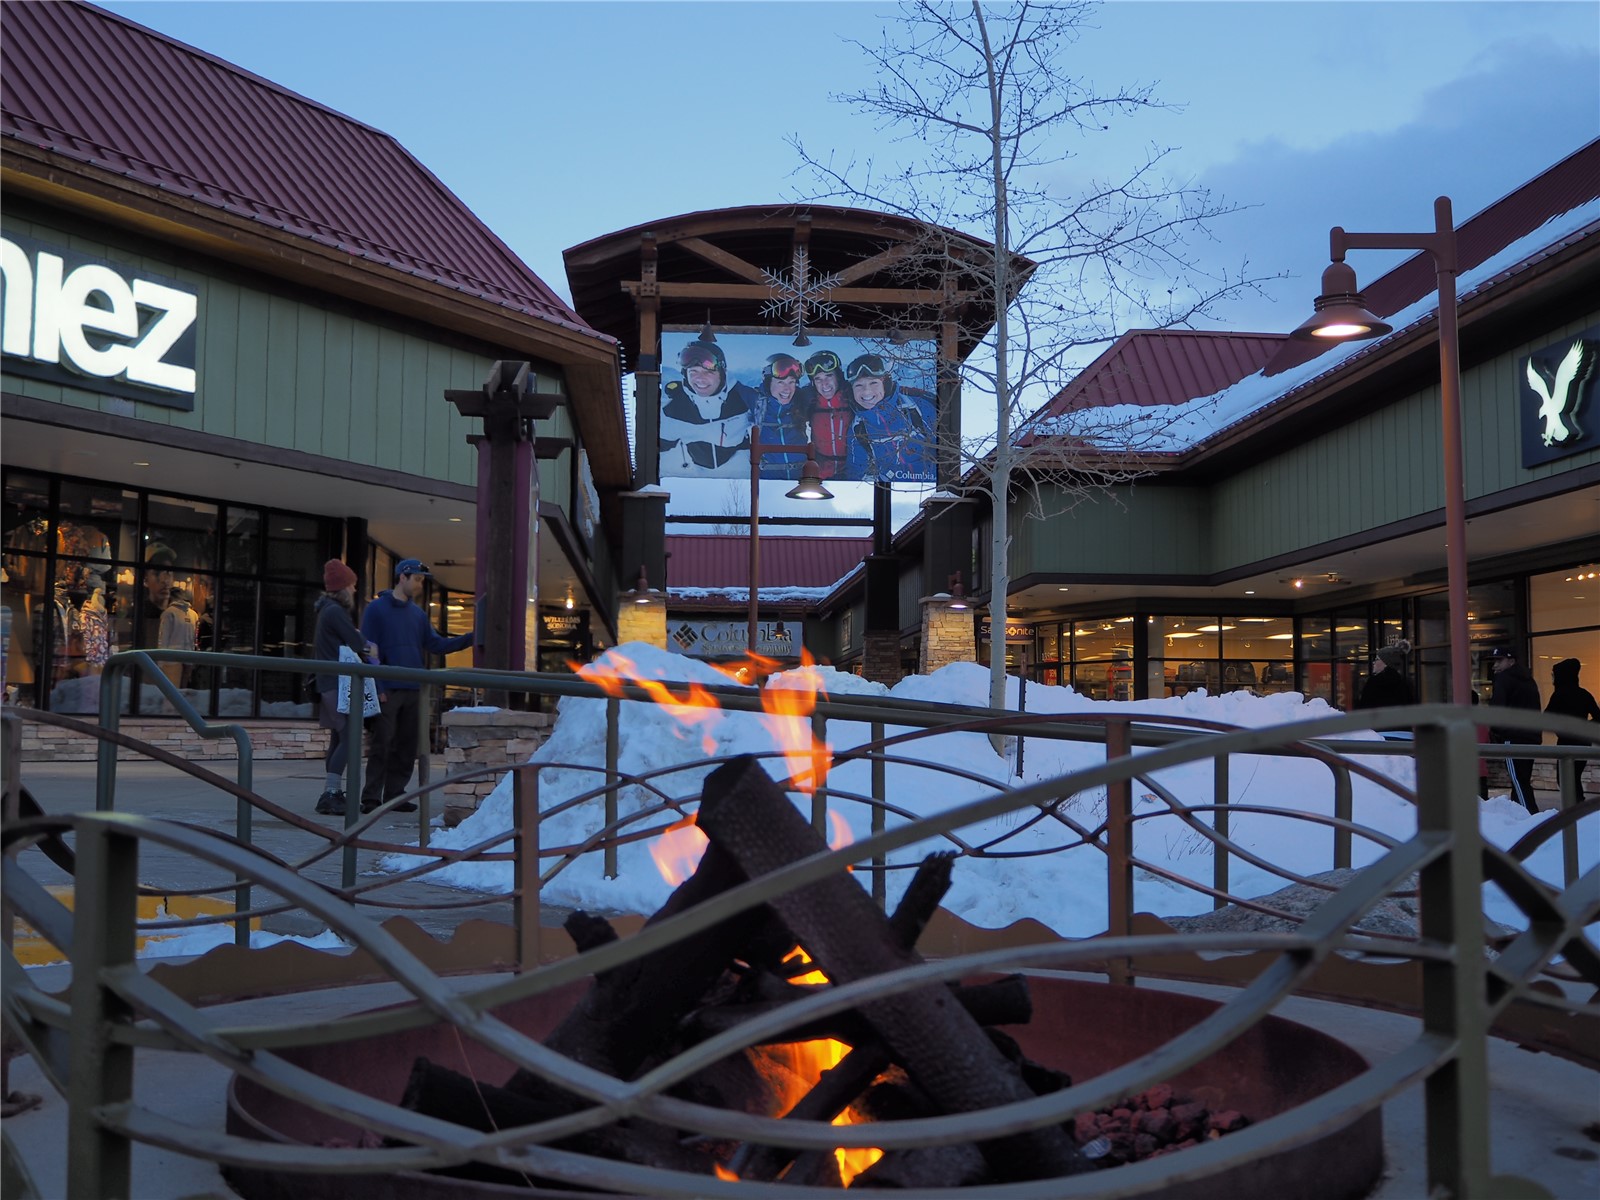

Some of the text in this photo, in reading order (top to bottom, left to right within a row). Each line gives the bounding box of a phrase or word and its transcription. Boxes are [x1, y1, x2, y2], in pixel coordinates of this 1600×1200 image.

[895, 470, 935, 480] Columbia
[701, 623, 792, 642] Coluba
[980, 625, 1035, 636] Sasonite
